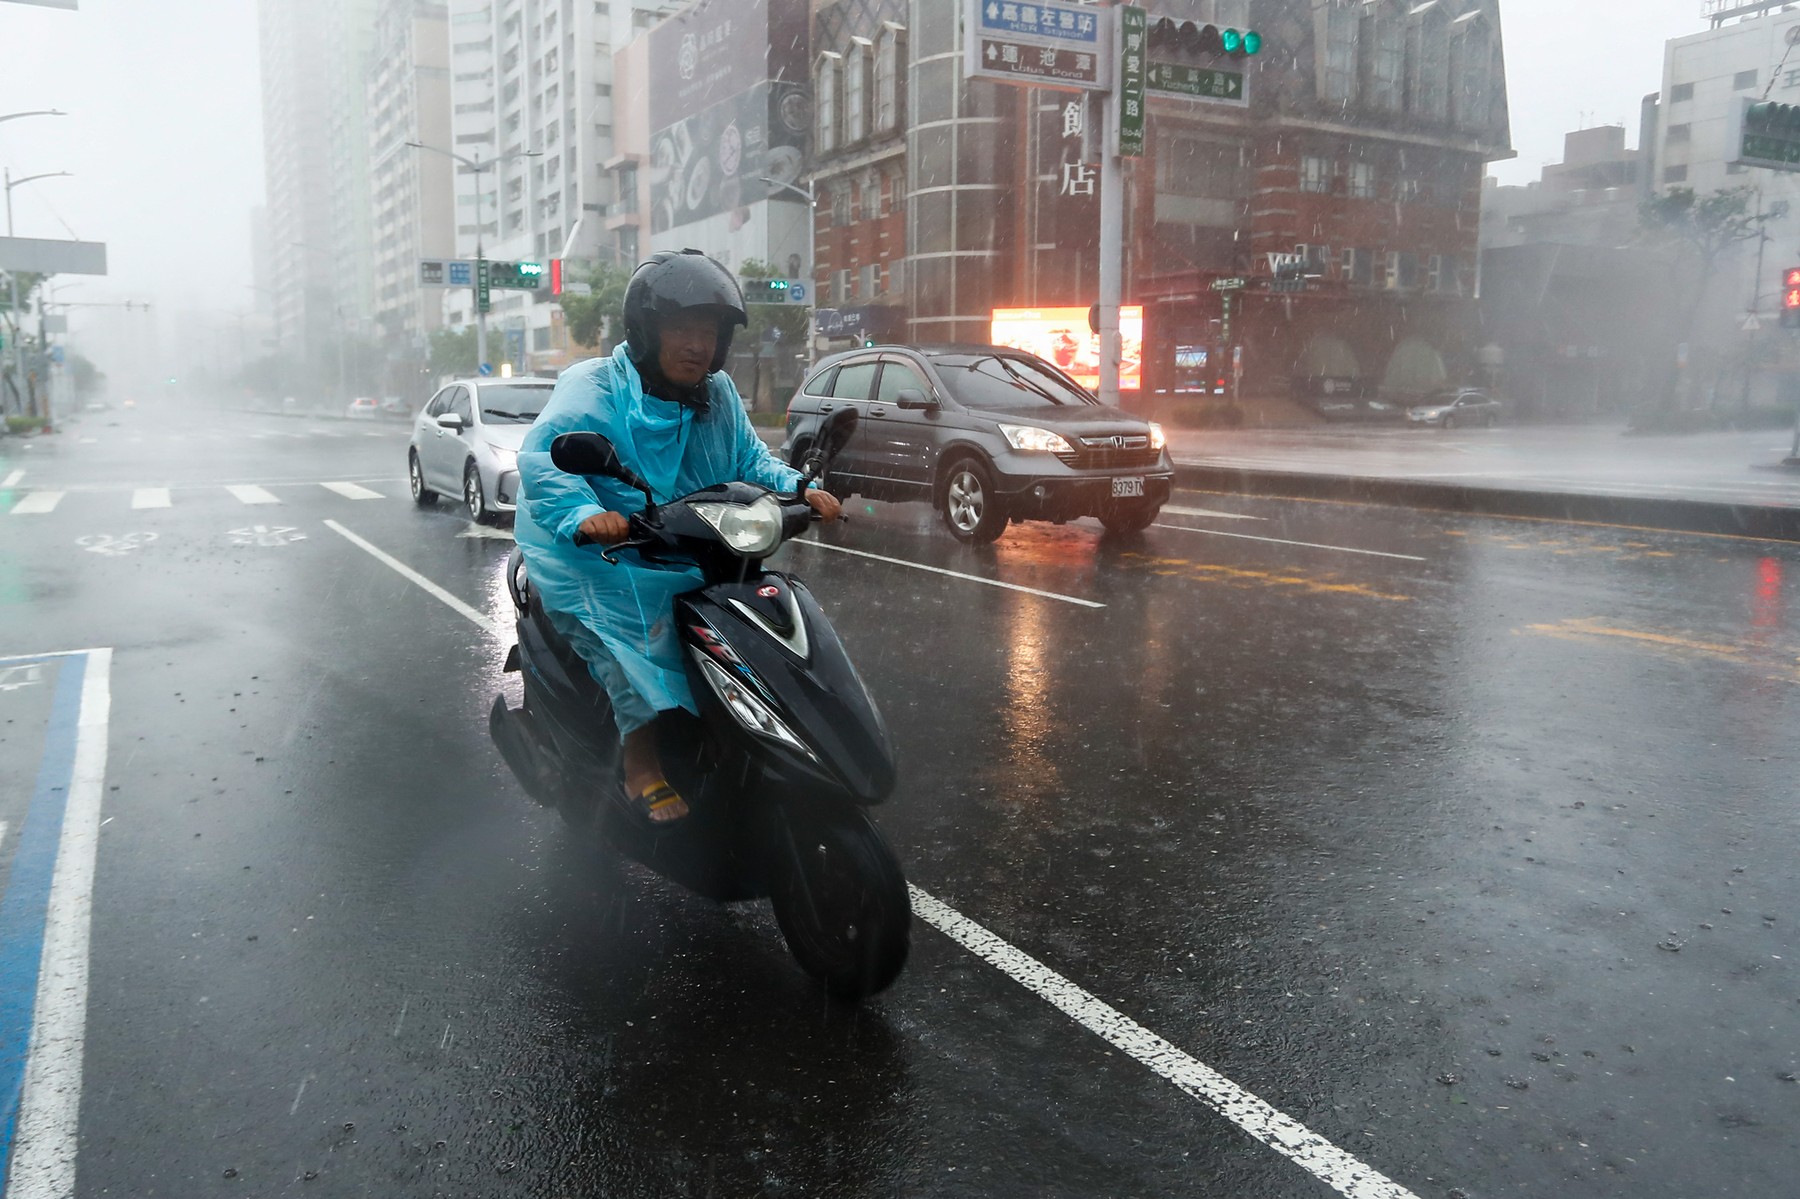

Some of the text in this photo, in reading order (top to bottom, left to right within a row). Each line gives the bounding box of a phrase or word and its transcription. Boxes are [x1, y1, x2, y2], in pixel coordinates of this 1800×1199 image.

[1011, 22, 1084, 38] HSR Station
[1002, 45, 1091, 70] 蓮池潭
[1011, 64, 1083, 78] Lotus Pond
[1127, 34, 1139, 117] 博愛二路
